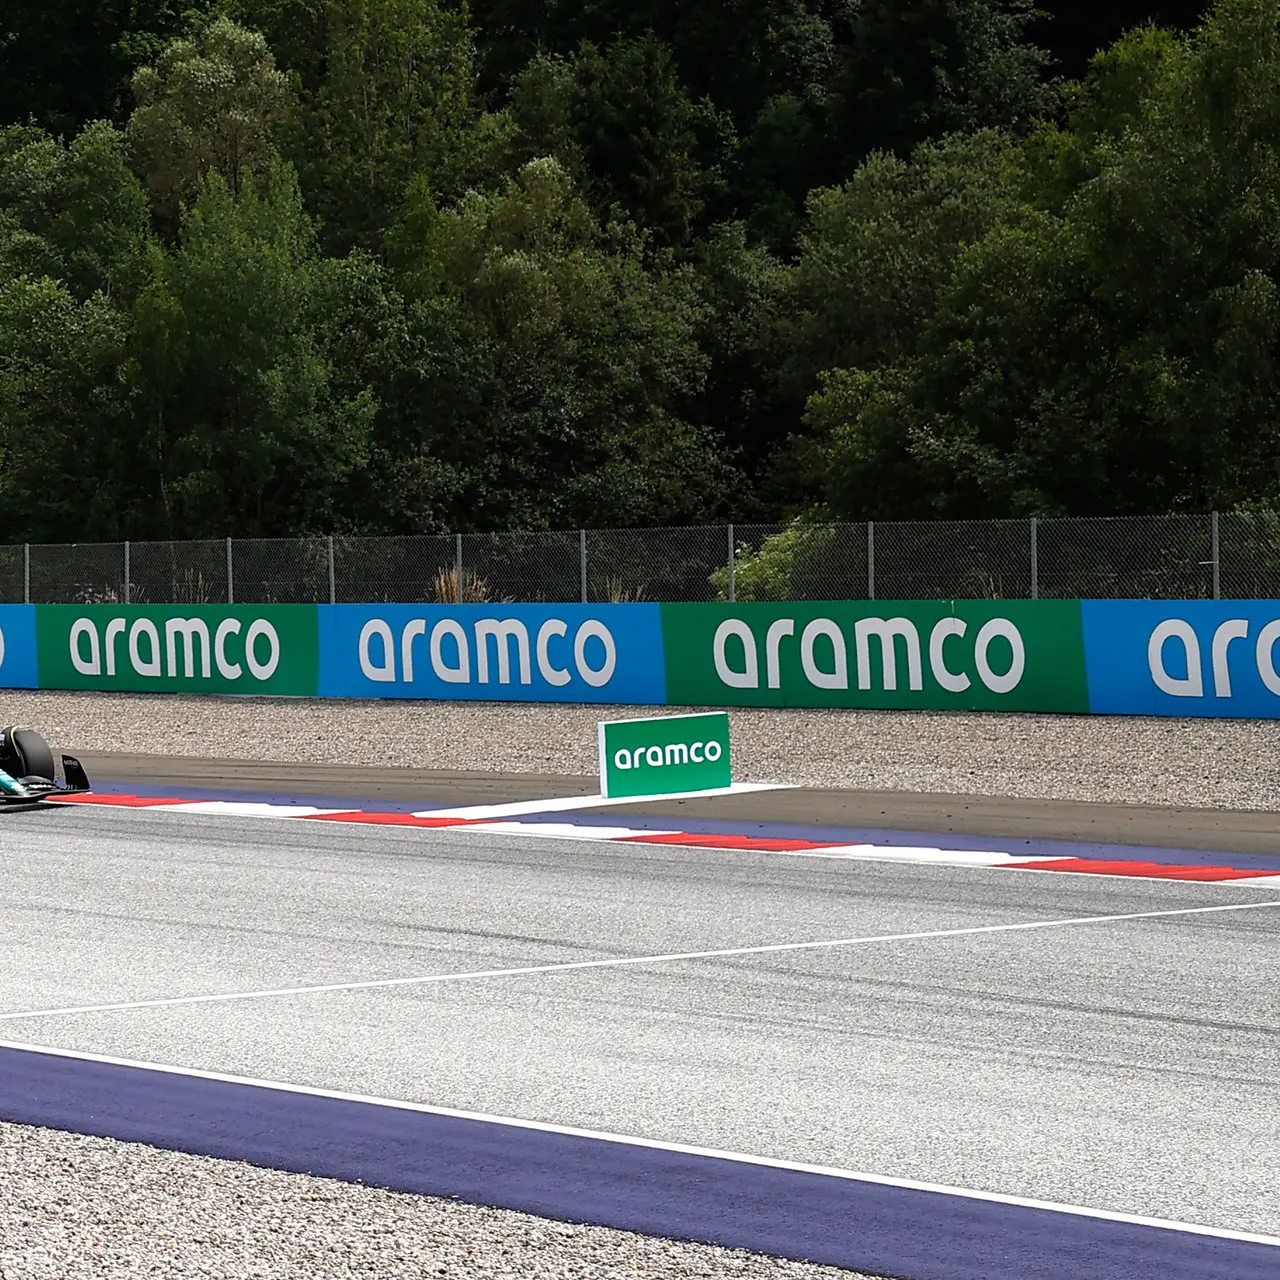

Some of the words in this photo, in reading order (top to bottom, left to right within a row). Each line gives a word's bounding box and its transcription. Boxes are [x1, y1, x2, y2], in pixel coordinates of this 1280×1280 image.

[69, 617, 280, 681] aramco
[358, 618, 617, 687] aramco
[713, 616, 1026, 694] aramco
[614, 740, 722, 770] aramco
